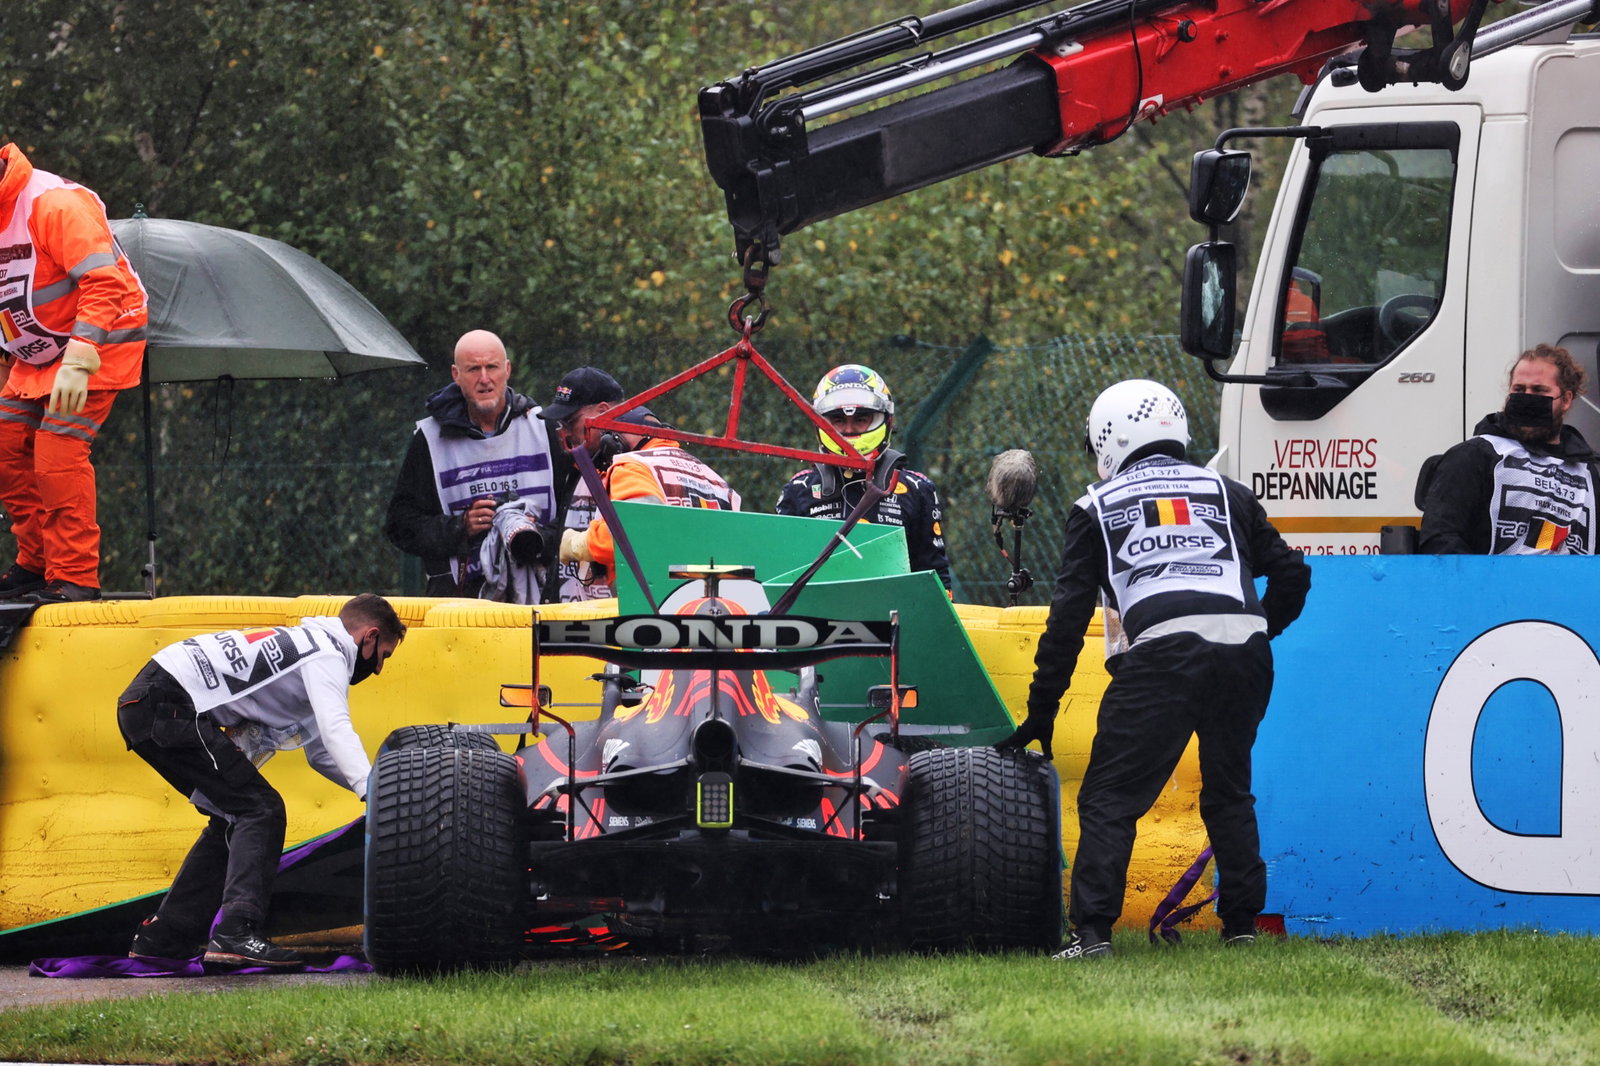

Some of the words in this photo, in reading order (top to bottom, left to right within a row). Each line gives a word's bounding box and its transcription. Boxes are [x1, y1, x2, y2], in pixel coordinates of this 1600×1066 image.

[1398, 373, 1436, 384] 260
[828, 383, 871, 393] HONDA
[1274, 438, 1378, 468] VERVIERS
[1126, 468, 1181, 481] BEL1376
[1252, 463, 1378, 500] DÉPANNAGE
[1128, 486, 1142, 494] FIRE
[810, 503, 833, 515] Mobil
[1127, 535, 1216, 557] COURSE
[546, 619, 883, 650] HONDA
